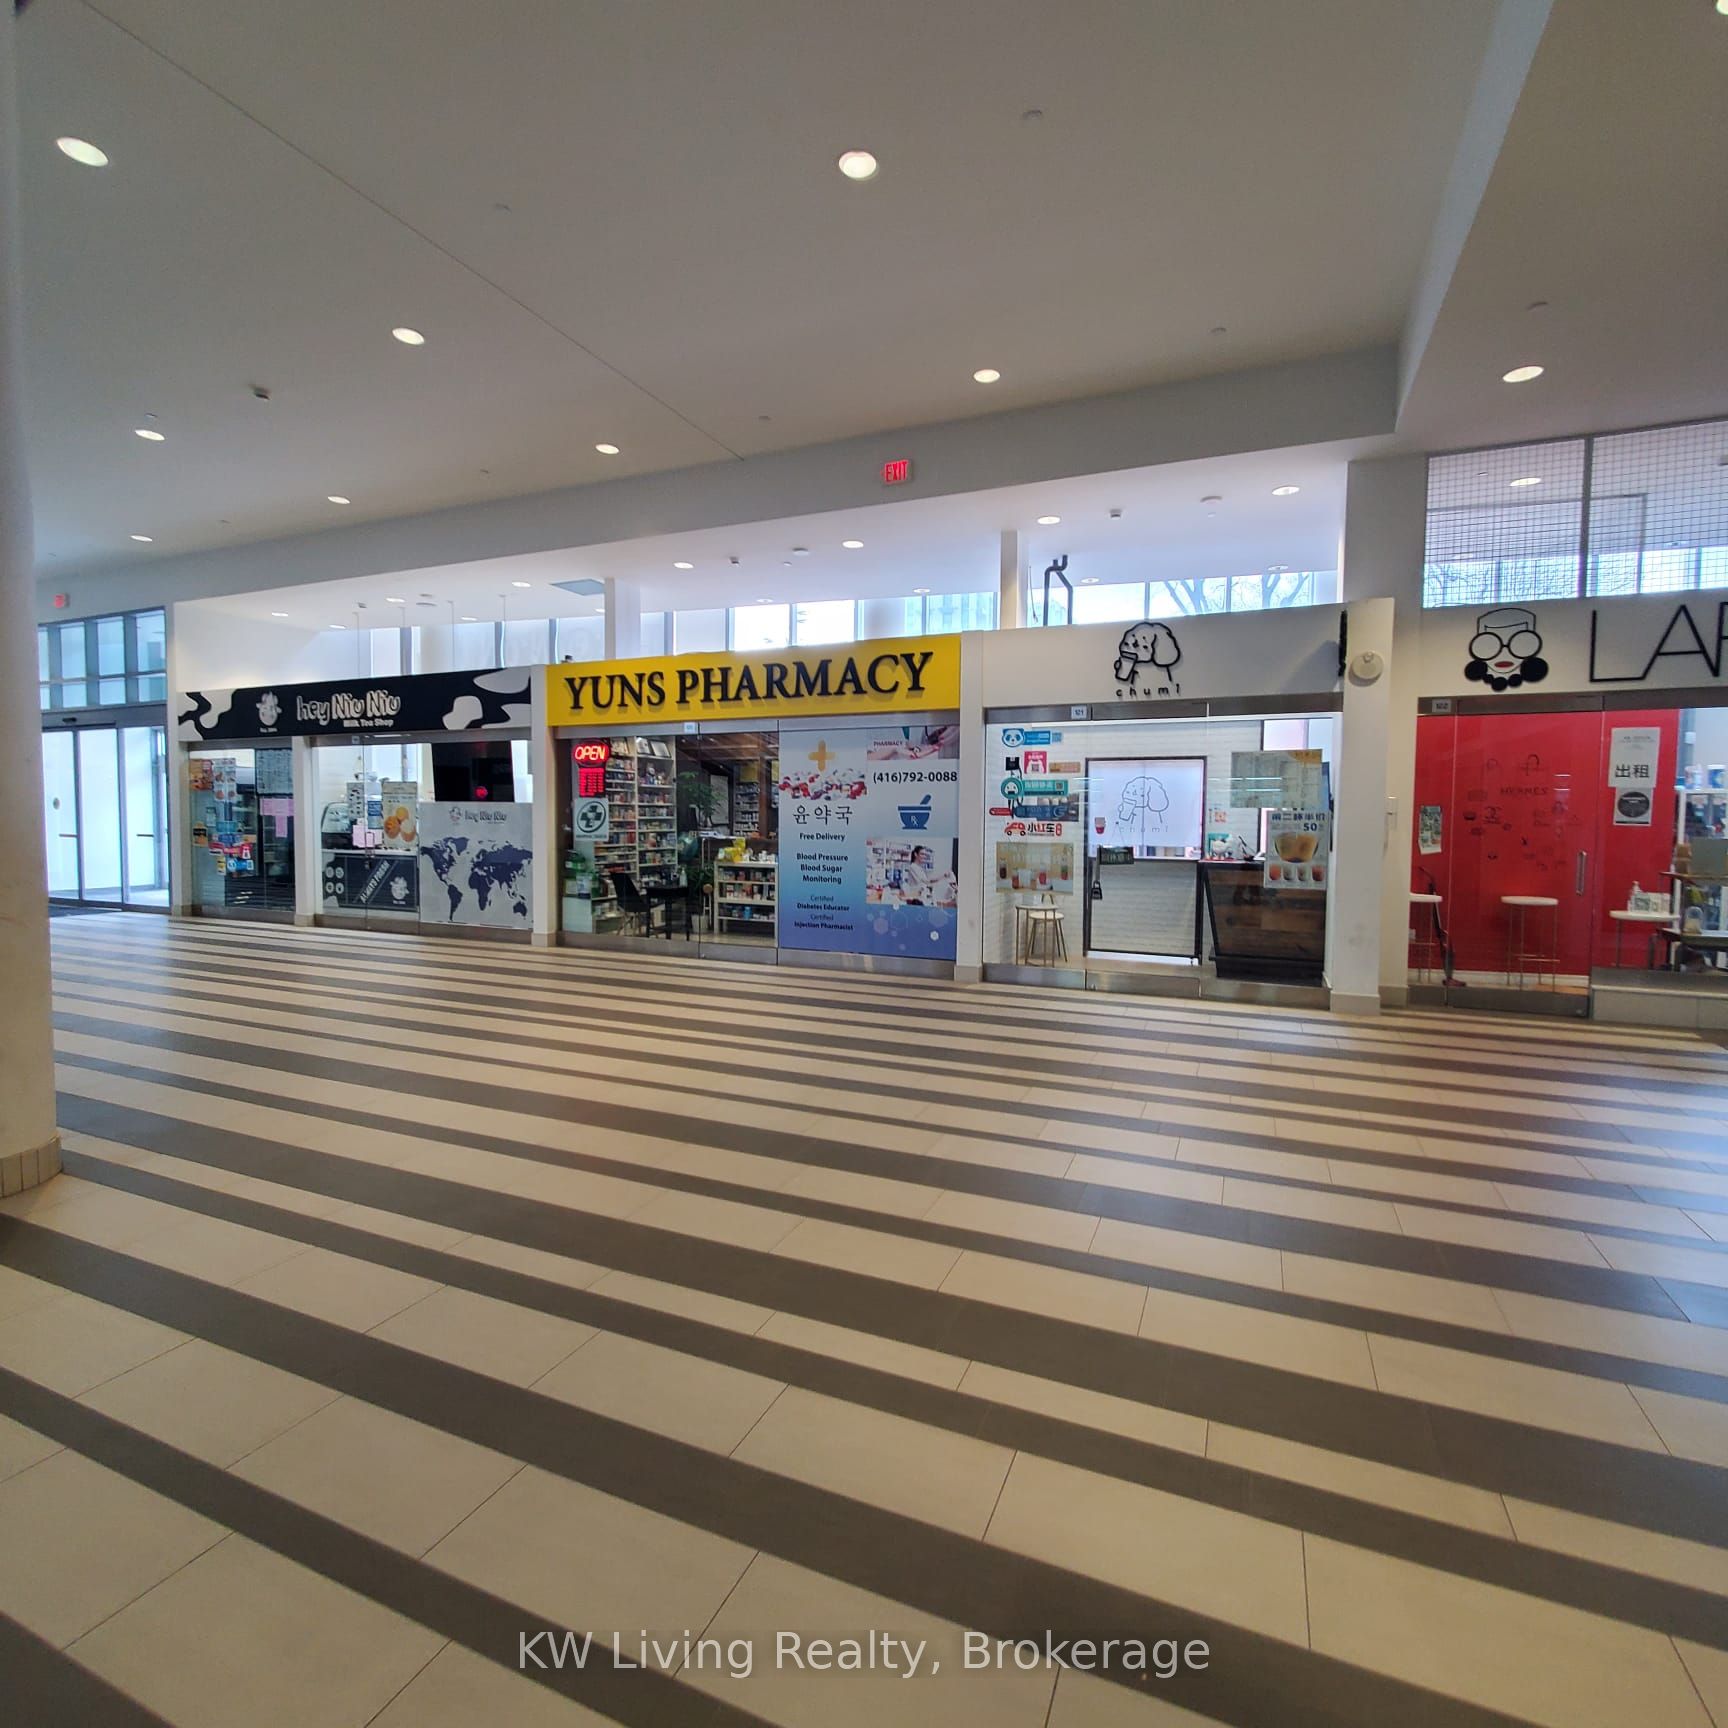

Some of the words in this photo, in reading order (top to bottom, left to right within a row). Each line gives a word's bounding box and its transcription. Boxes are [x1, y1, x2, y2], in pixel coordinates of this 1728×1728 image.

[886, 461, 907, 482] EXIT
[1590, 601, 1728, 682] LA
[565, 671, 666, 710] YUNS
[676, 652, 934, 704] PHARMACY
[1116, 684, 1180, 697] chumi
[296, 696, 330, 726] hey
[332, 692, 365, 720] Niu
[366, 690, 401, 717] Niu
[374, 718, 394, 727] Shop
[575, 746, 606, 761] OPEN
[873, 771, 958, 784] (416)792-0088
[1615, 764, 1650, 778] 出租
[793, 805, 852, 826] 윤약국
[816, 833, 845, 842] Delivery
[818, 853, 848, 861] Pressure
[822, 864, 842, 873] Sugar
[802, 875, 842, 884] Monitoring
[821, 922, 854, 930] Pharmacist
